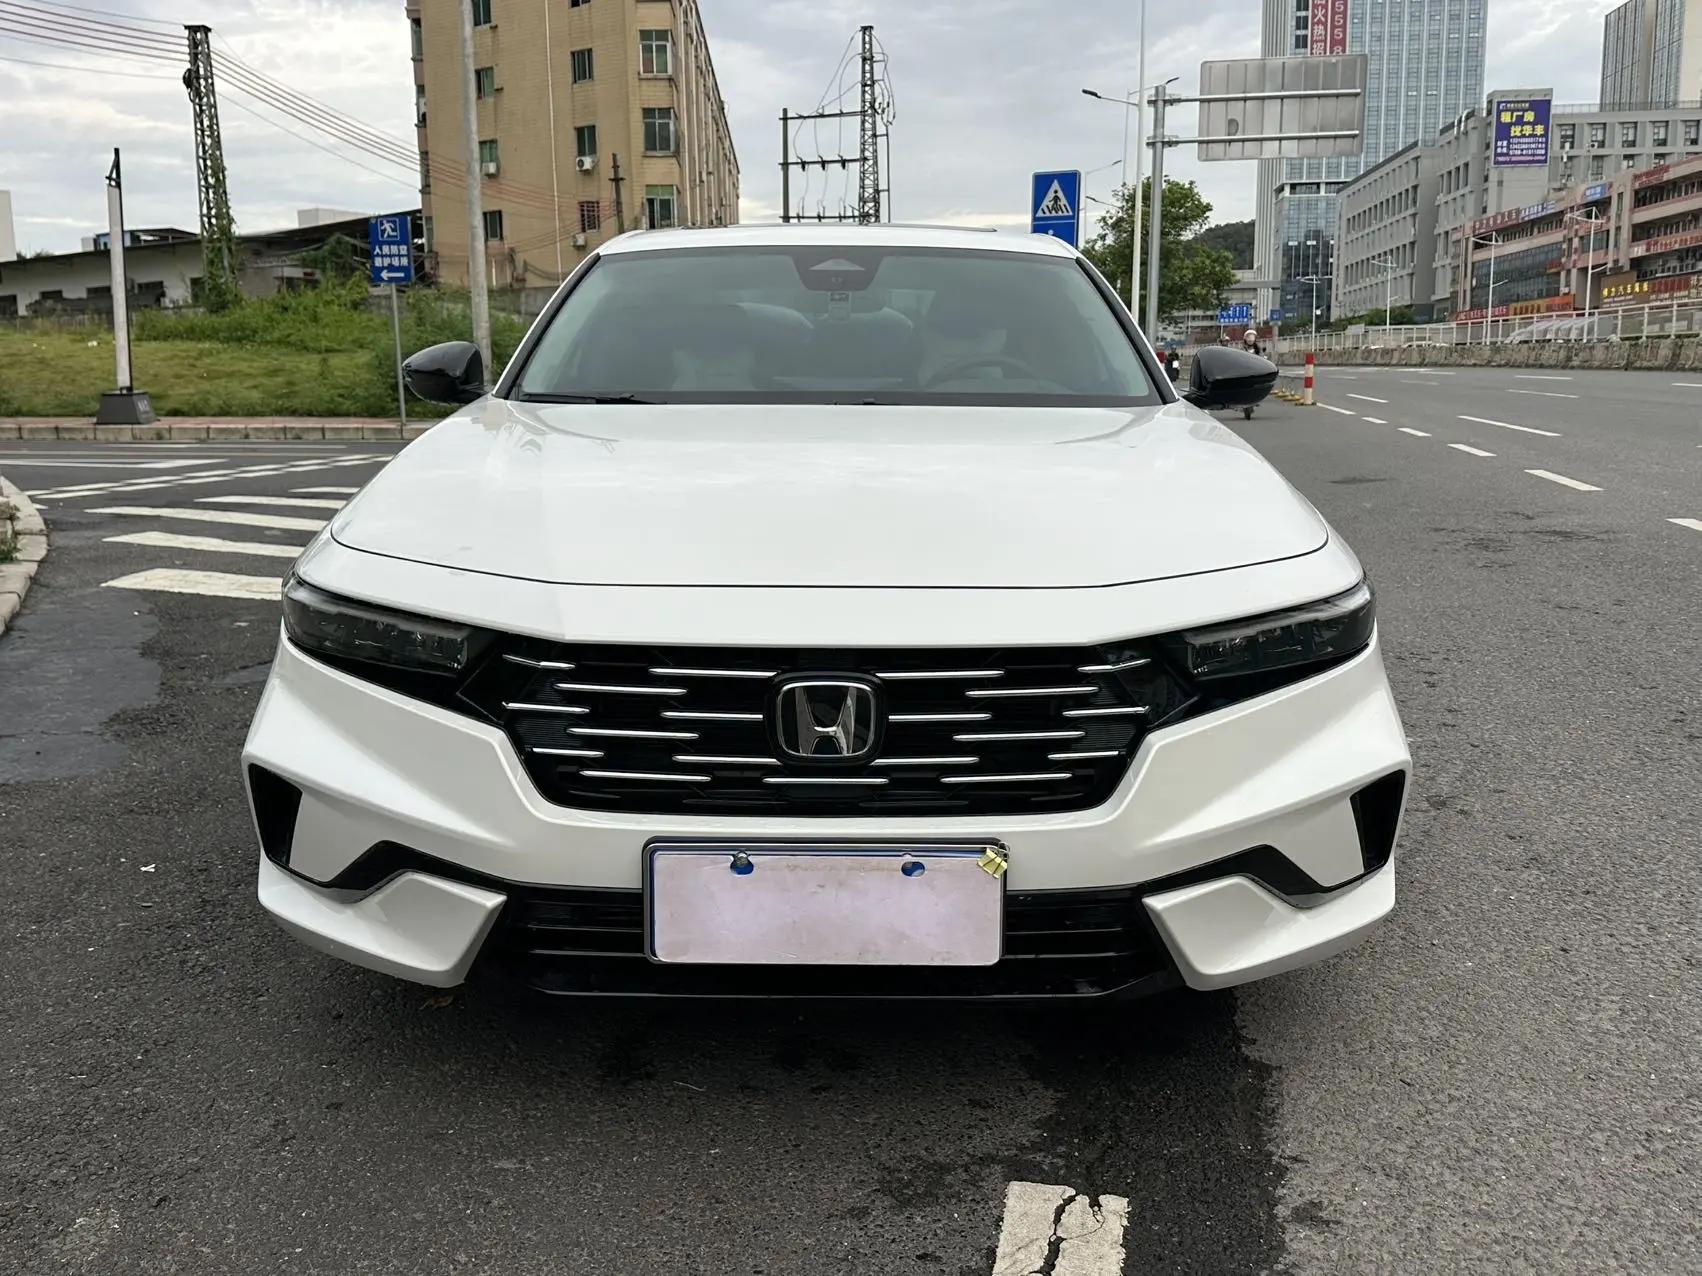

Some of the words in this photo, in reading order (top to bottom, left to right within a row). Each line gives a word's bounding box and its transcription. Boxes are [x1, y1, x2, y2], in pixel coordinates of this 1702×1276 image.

[1500, 111, 1535, 123] 租厂房
[1510, 125, 1544, 137] 找华丰
[373, 245, 408, 255] 人民防空
